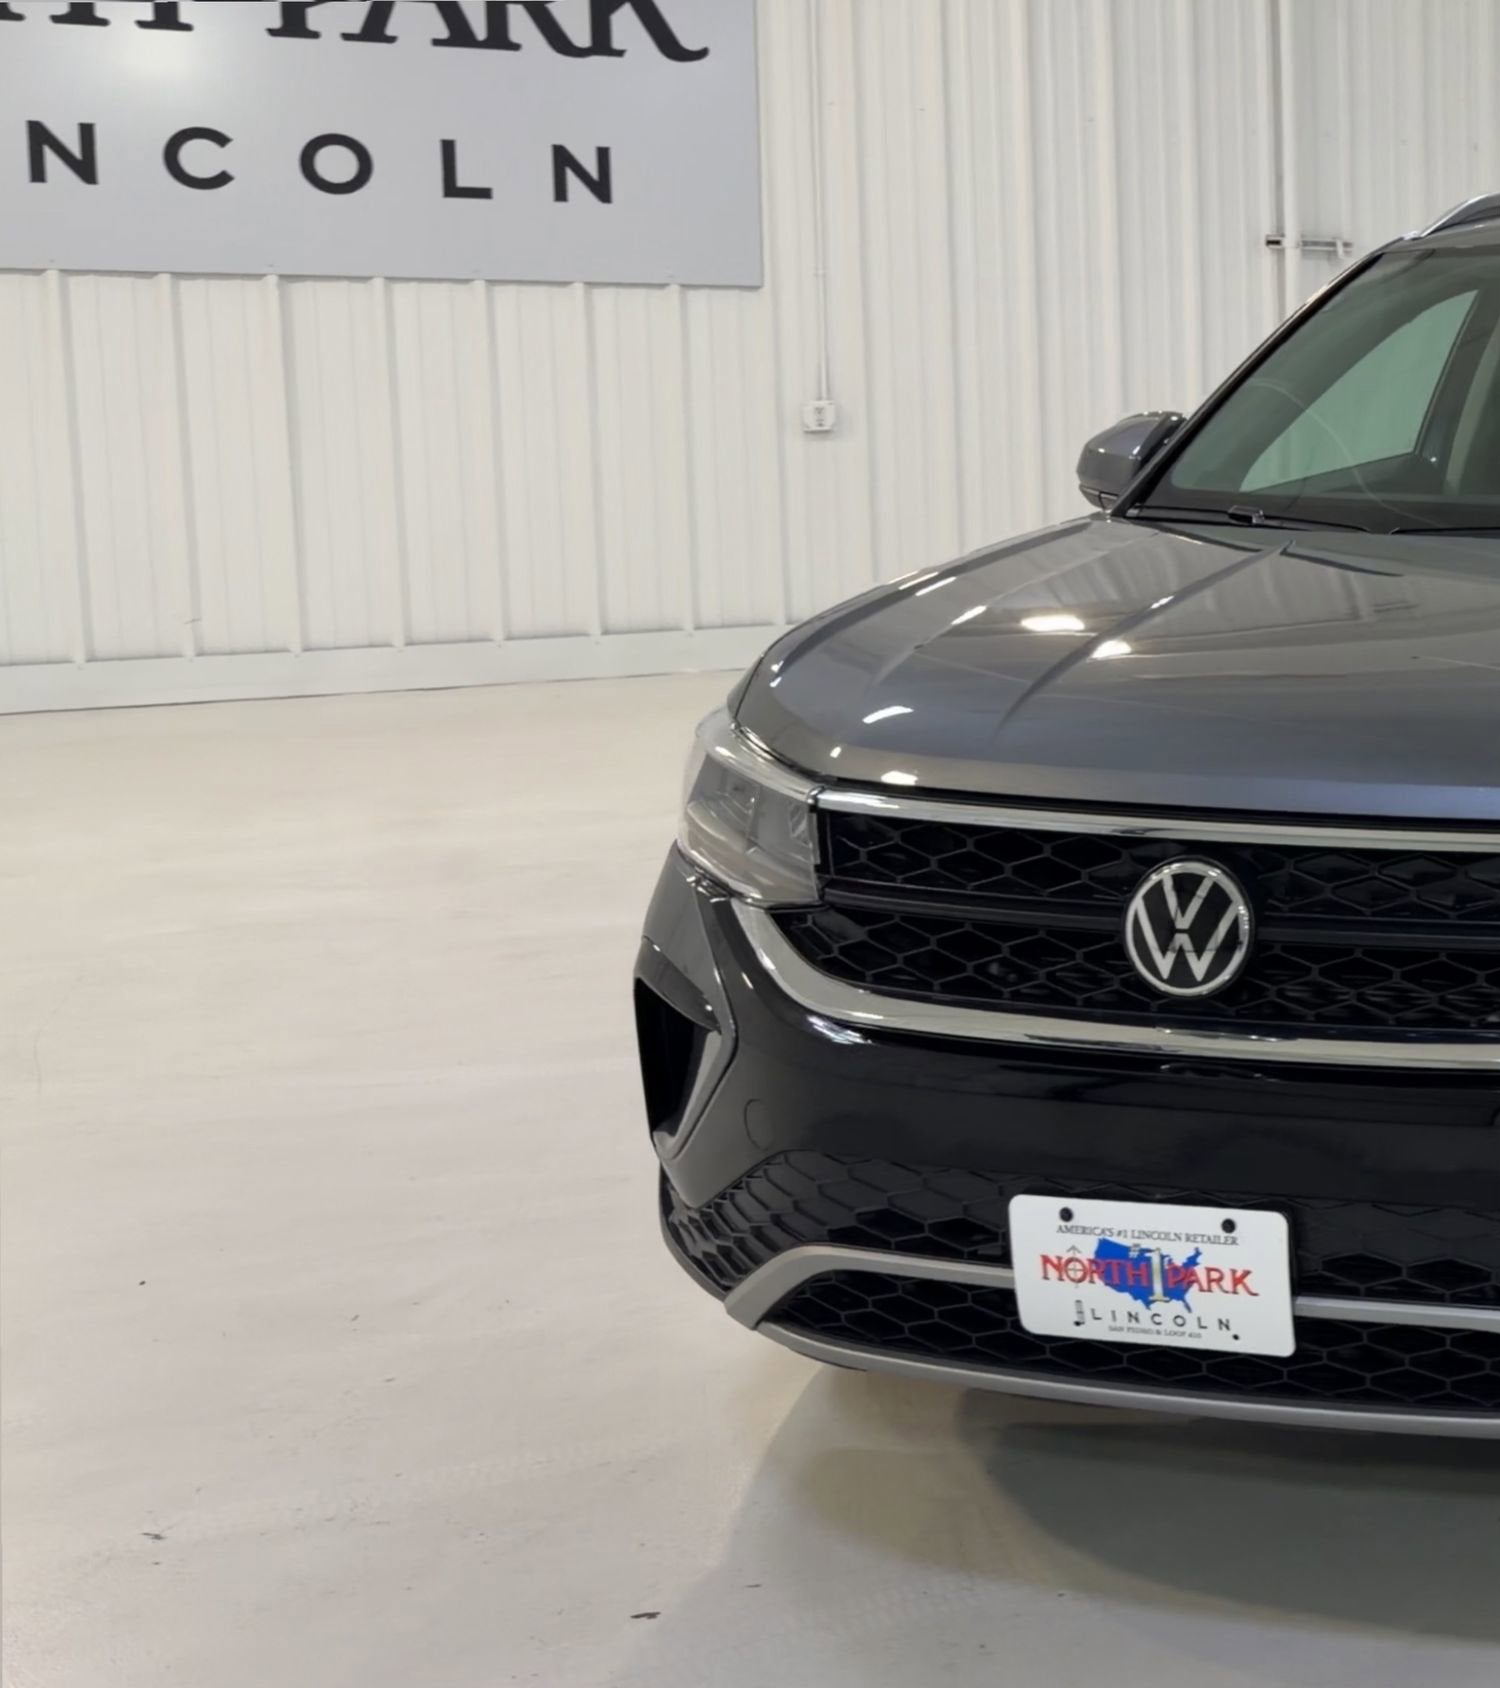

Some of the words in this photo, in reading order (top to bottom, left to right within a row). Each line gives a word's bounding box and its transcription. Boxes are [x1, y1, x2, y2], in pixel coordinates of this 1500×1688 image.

[1056, 1224, 1114, 1238] AMERICA'S
[1116, 1229, 1128, 1239] #1
[1131, 1229, 1183, 1243] LINCOLN
[1184, 1232, 1239, 1246] RETAILER
[1040, 1254, 1149, 1287] NORTH
[1167, 1262, 1260, 1297] PARK
[1091, 1307, 1231, 1332] LINCOLN
